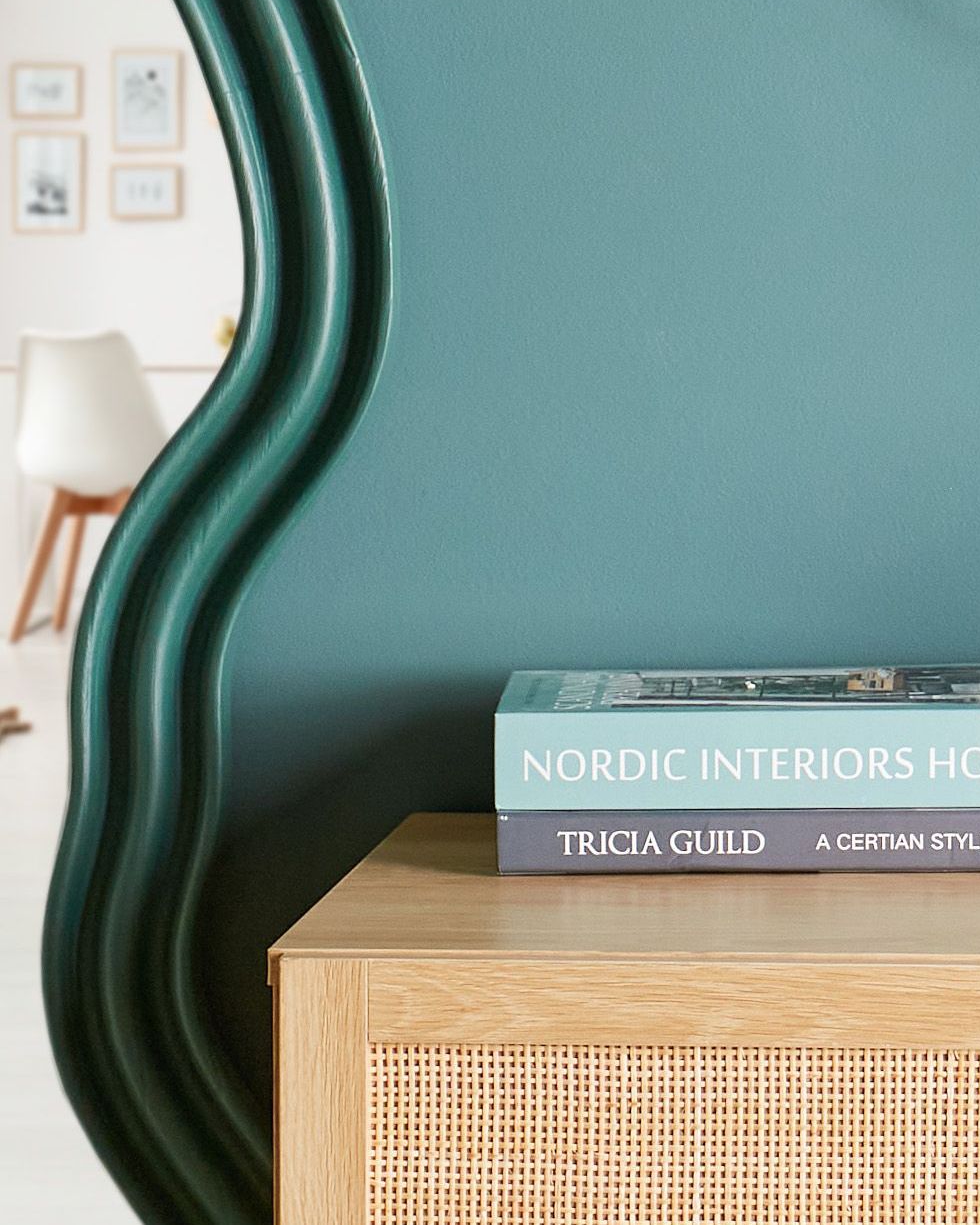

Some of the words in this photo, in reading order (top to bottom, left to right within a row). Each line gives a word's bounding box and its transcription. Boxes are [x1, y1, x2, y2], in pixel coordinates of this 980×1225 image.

[522, 748, 688, 782] NORDIC
[701, 747, 914, 780] INTERIORS
[557, 830, 662, 855] TRICIA
[669, 829, 766, 855] GUILD
[815, 833, 831, 851] A
[836, 833, 924, 851] CERTIAN
